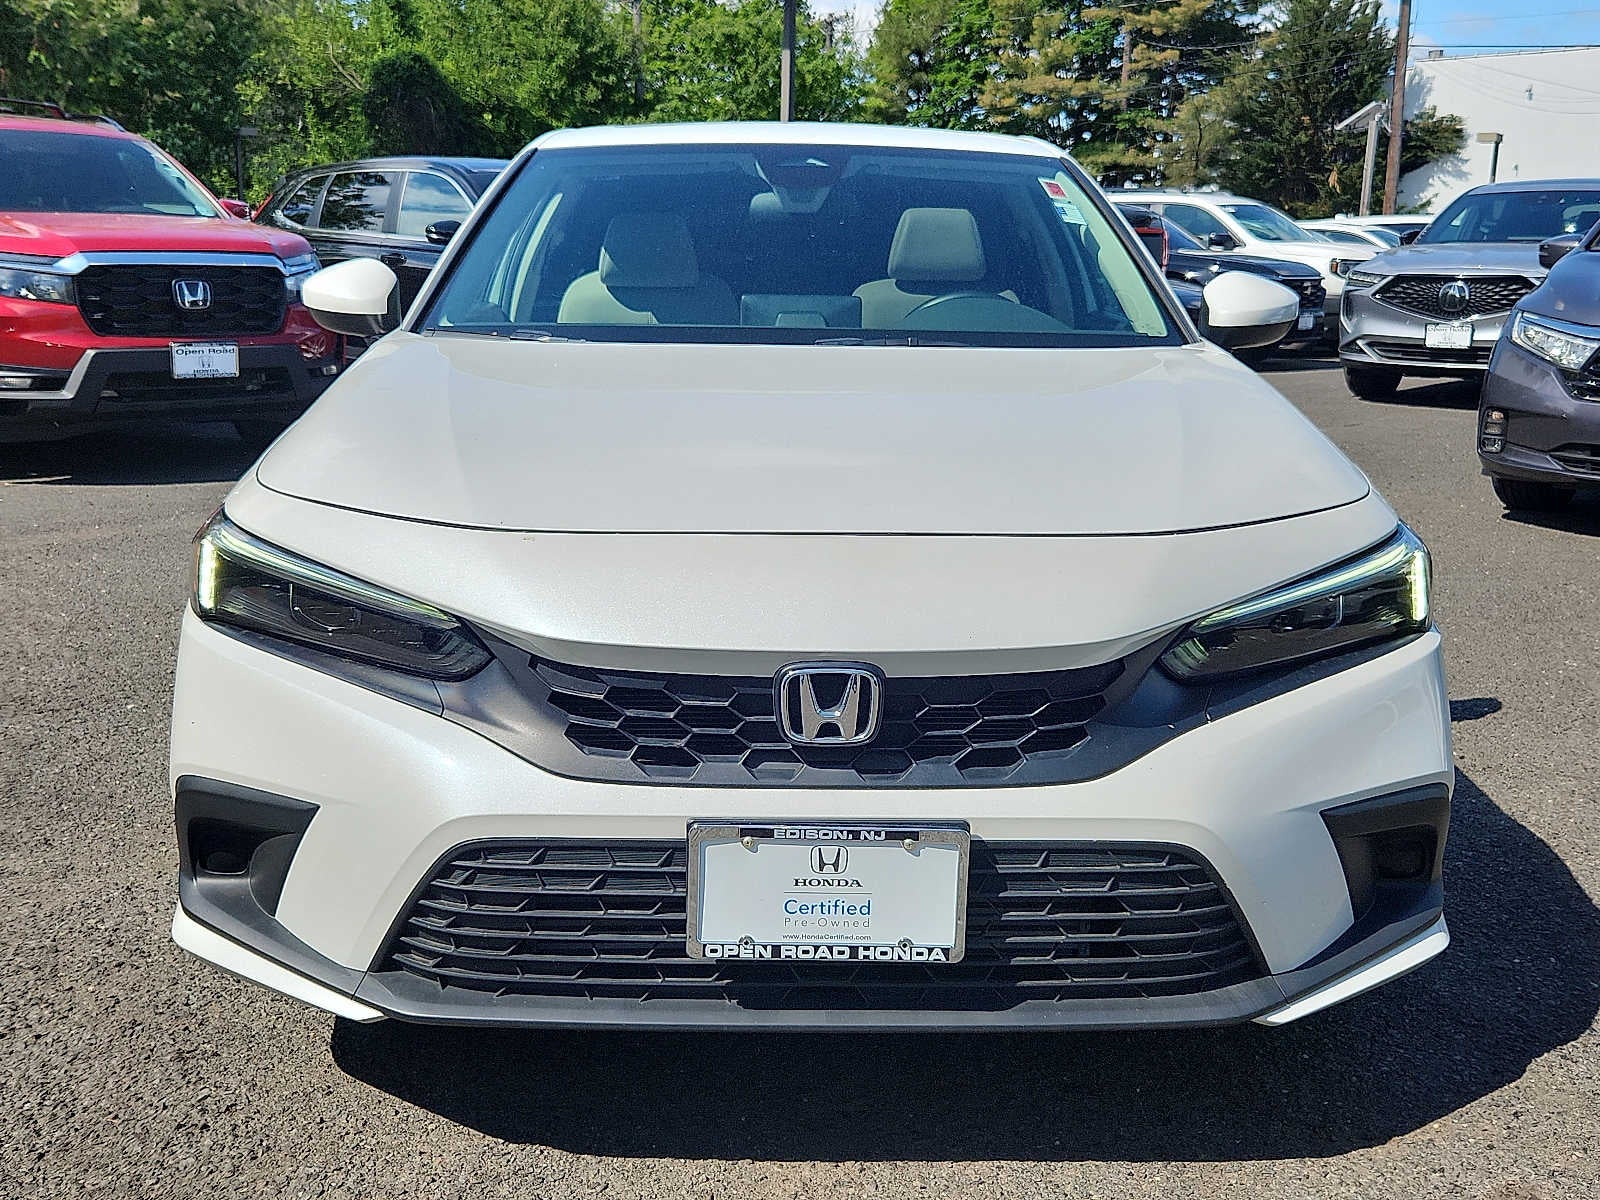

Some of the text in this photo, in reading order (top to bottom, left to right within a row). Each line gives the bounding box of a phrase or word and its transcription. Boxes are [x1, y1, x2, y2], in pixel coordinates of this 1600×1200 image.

[175, 347, 235, 356] Open Road
[860, 830, 886, 841] NJ
[793, 878, 864, 888] HONDA
[783, 898, 872, 916] Certified
[783, 917, 871, 928] Pre-Owned
[782, 933, 872, 941] www.HondaCertified.com
[705, 944, 947, 961] OPEN ROAD HONDA
